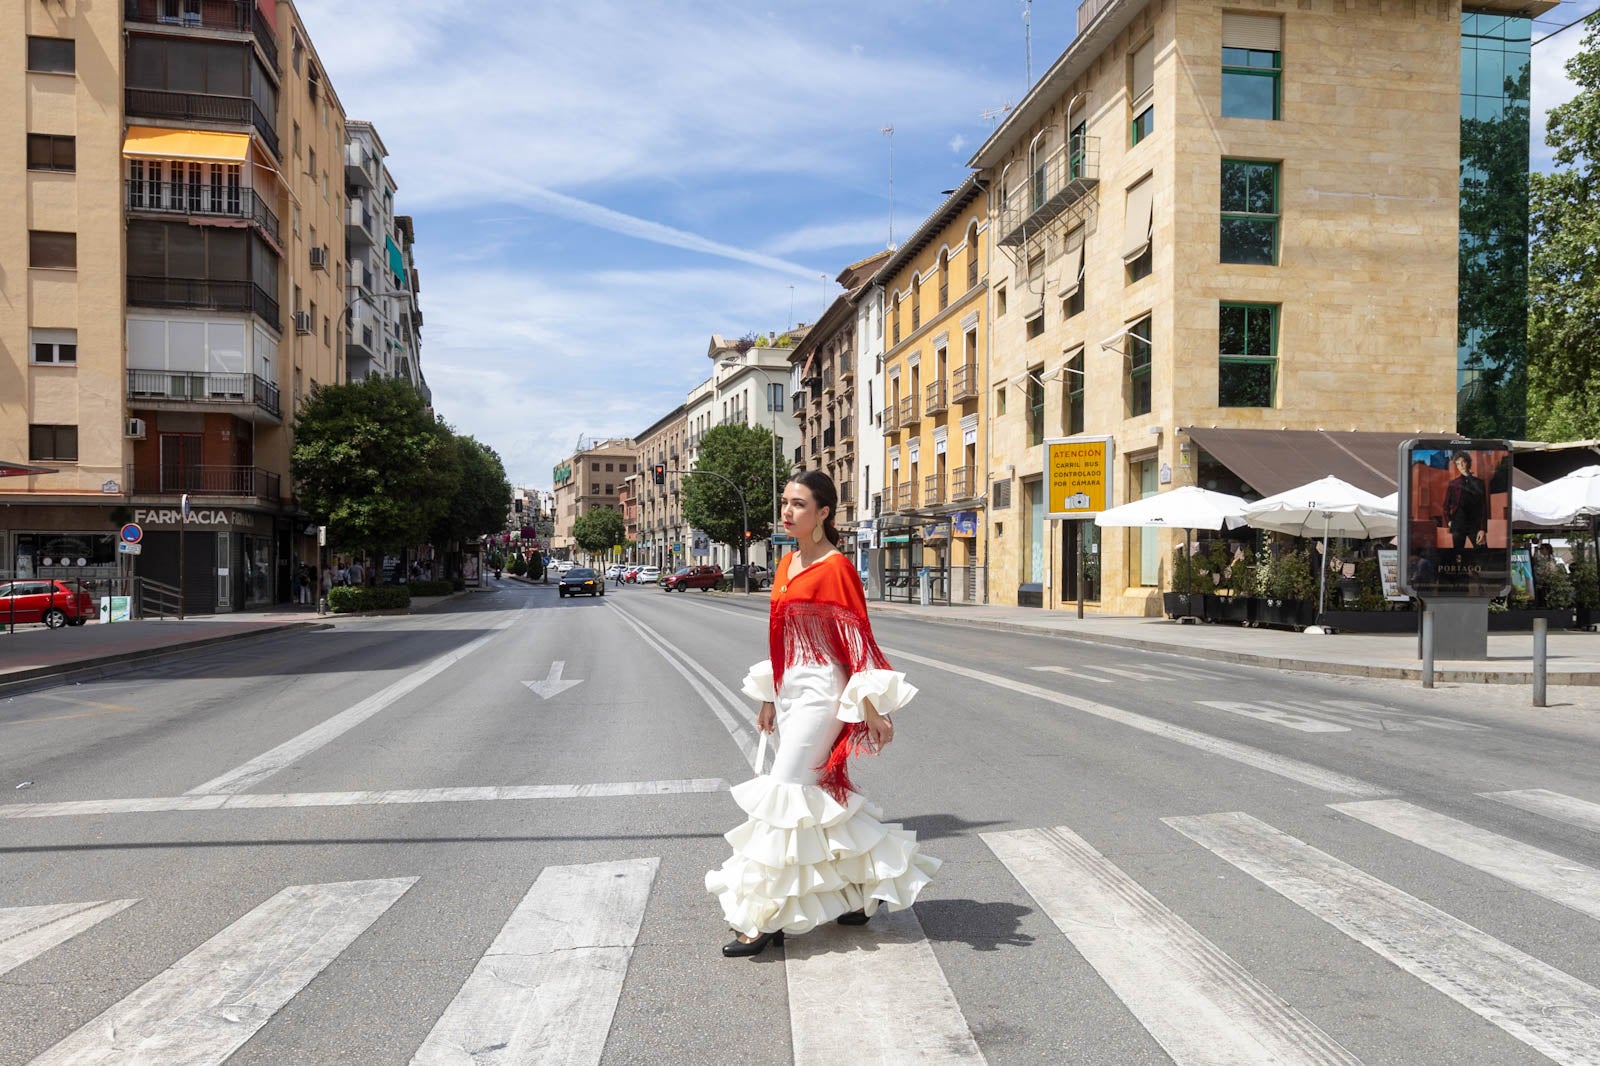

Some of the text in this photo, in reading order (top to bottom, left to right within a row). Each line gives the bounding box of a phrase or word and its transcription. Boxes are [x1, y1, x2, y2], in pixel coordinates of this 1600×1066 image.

[134, 509, 229, 524] FARMACIA
[1437, 565, 1482, 573] PORTAGO
[1191, 699, 1492, 733] BUS
